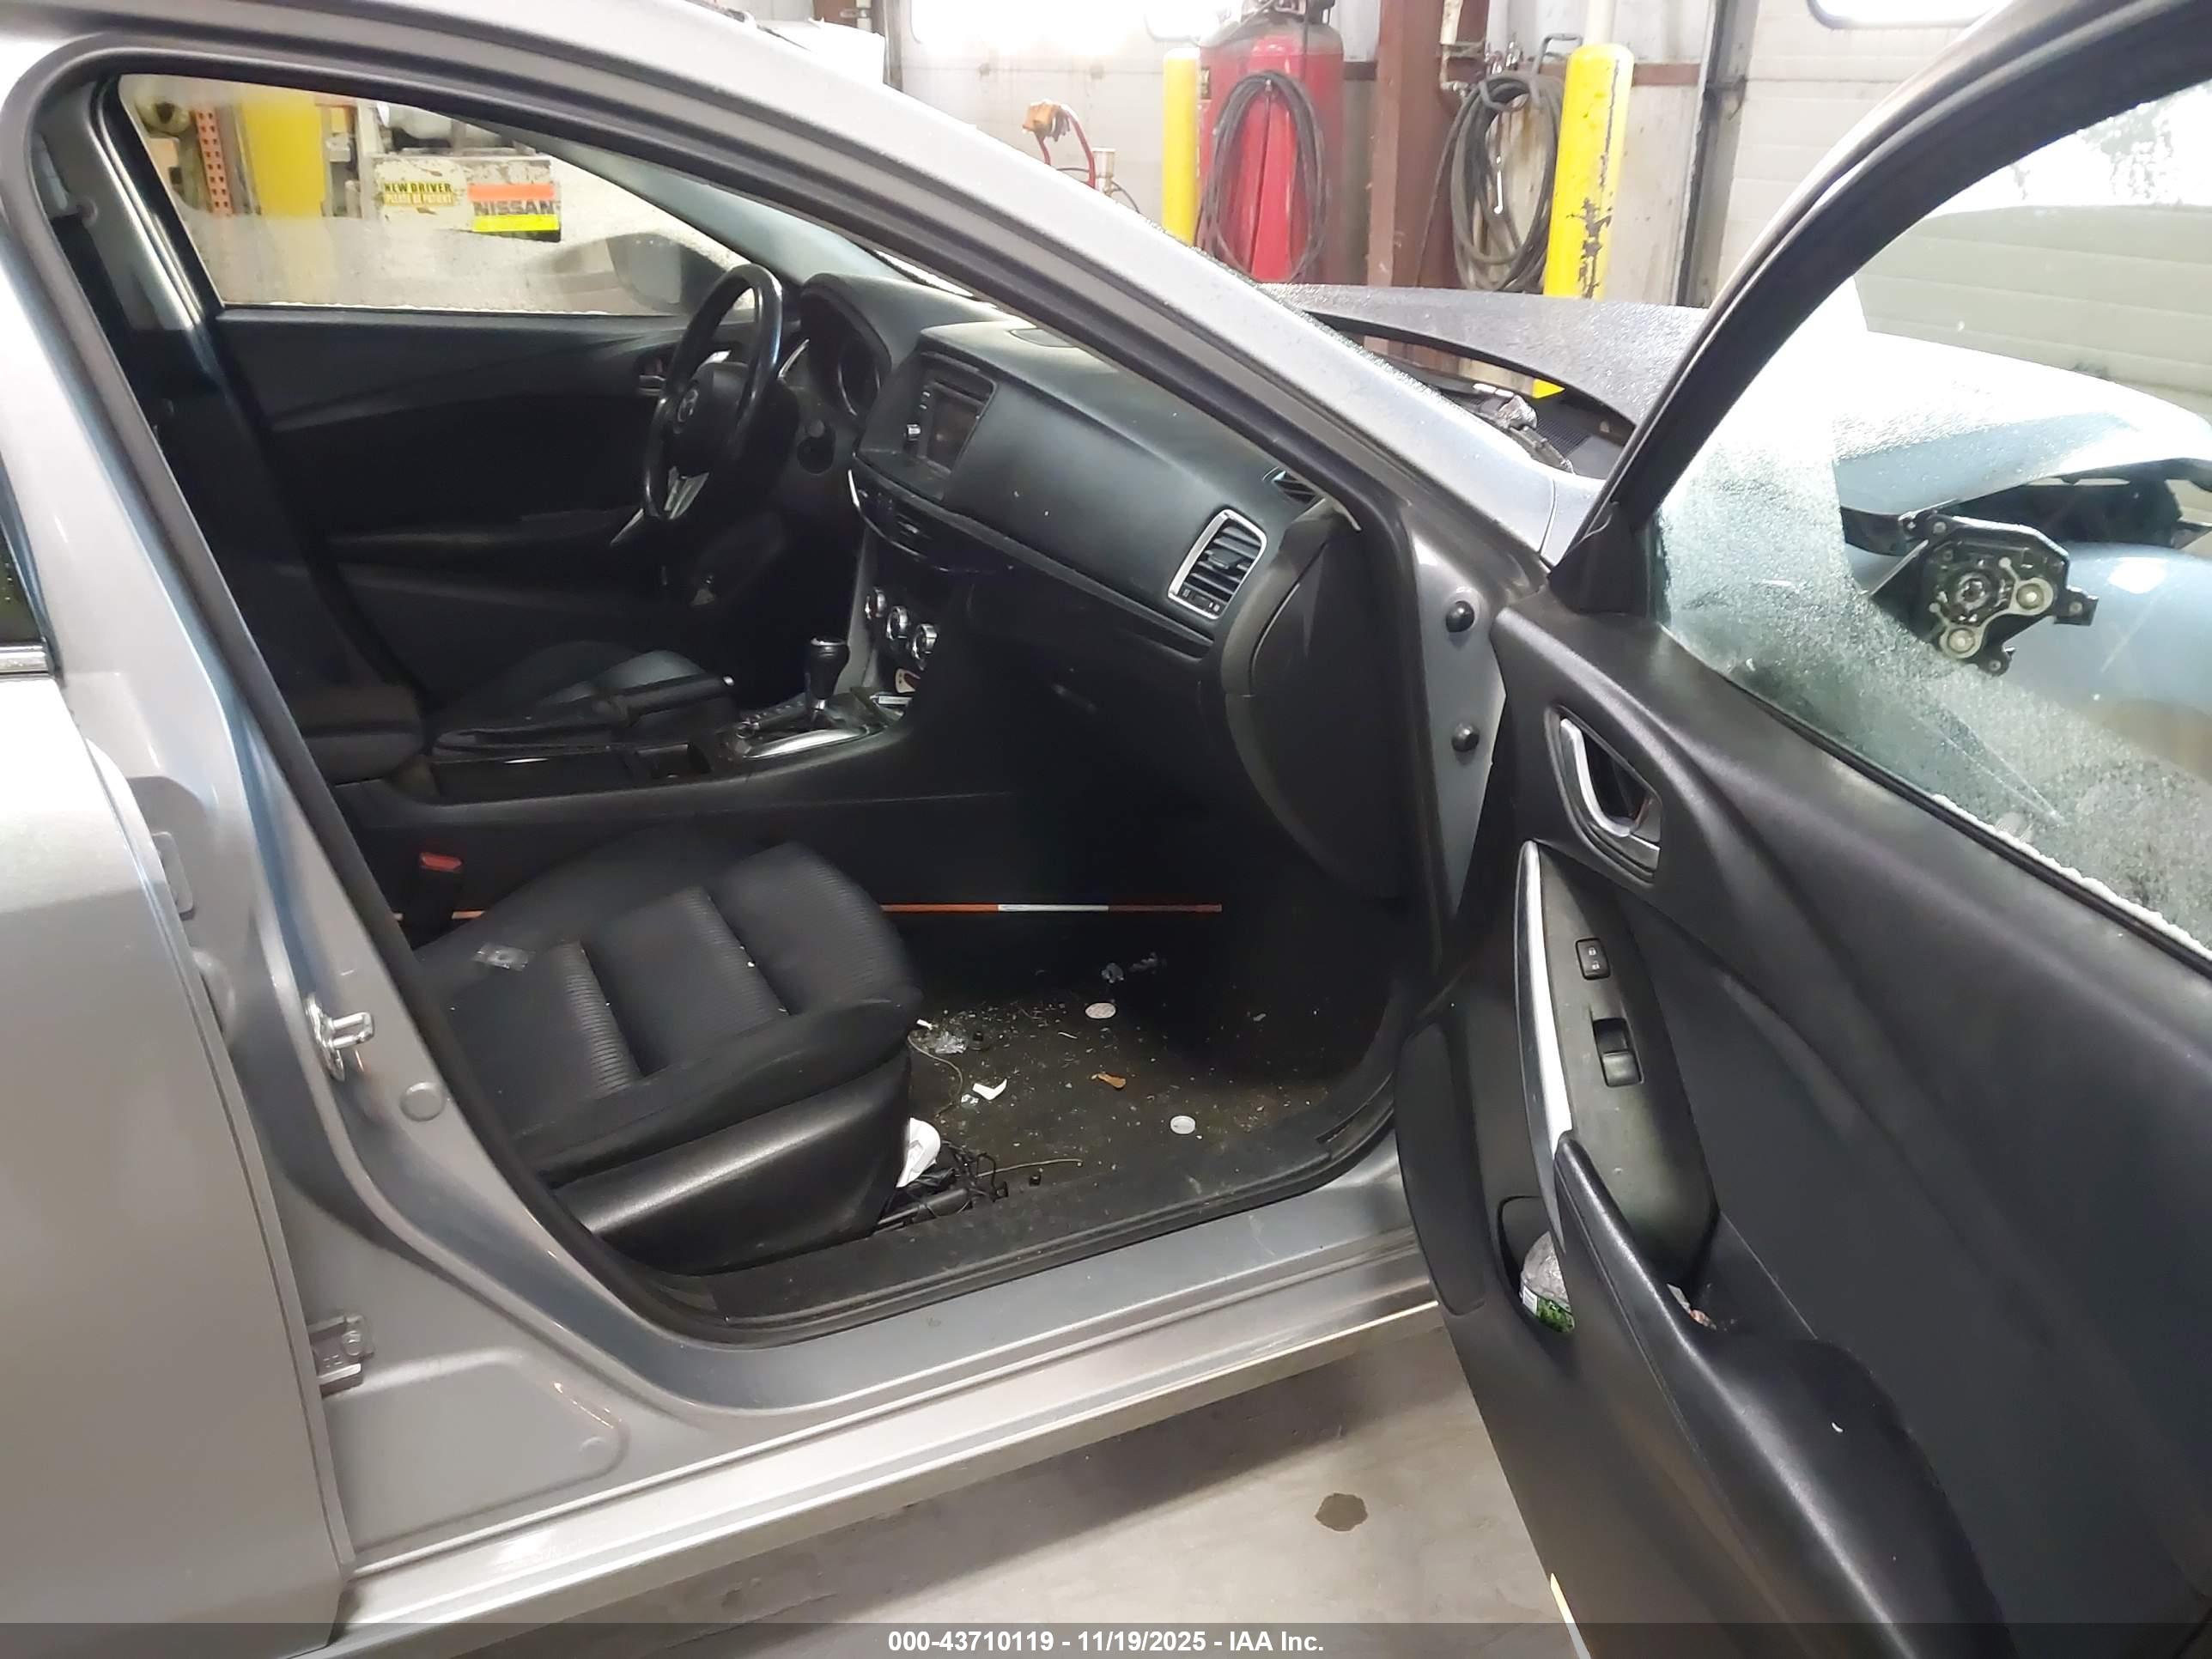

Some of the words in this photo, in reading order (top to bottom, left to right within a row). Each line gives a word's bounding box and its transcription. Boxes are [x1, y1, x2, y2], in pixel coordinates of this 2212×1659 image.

[384, 182, 408, 193] NEW
[410, 182, 453, 193] DRIVER
[473, 200, 556, 216] NISSAN
